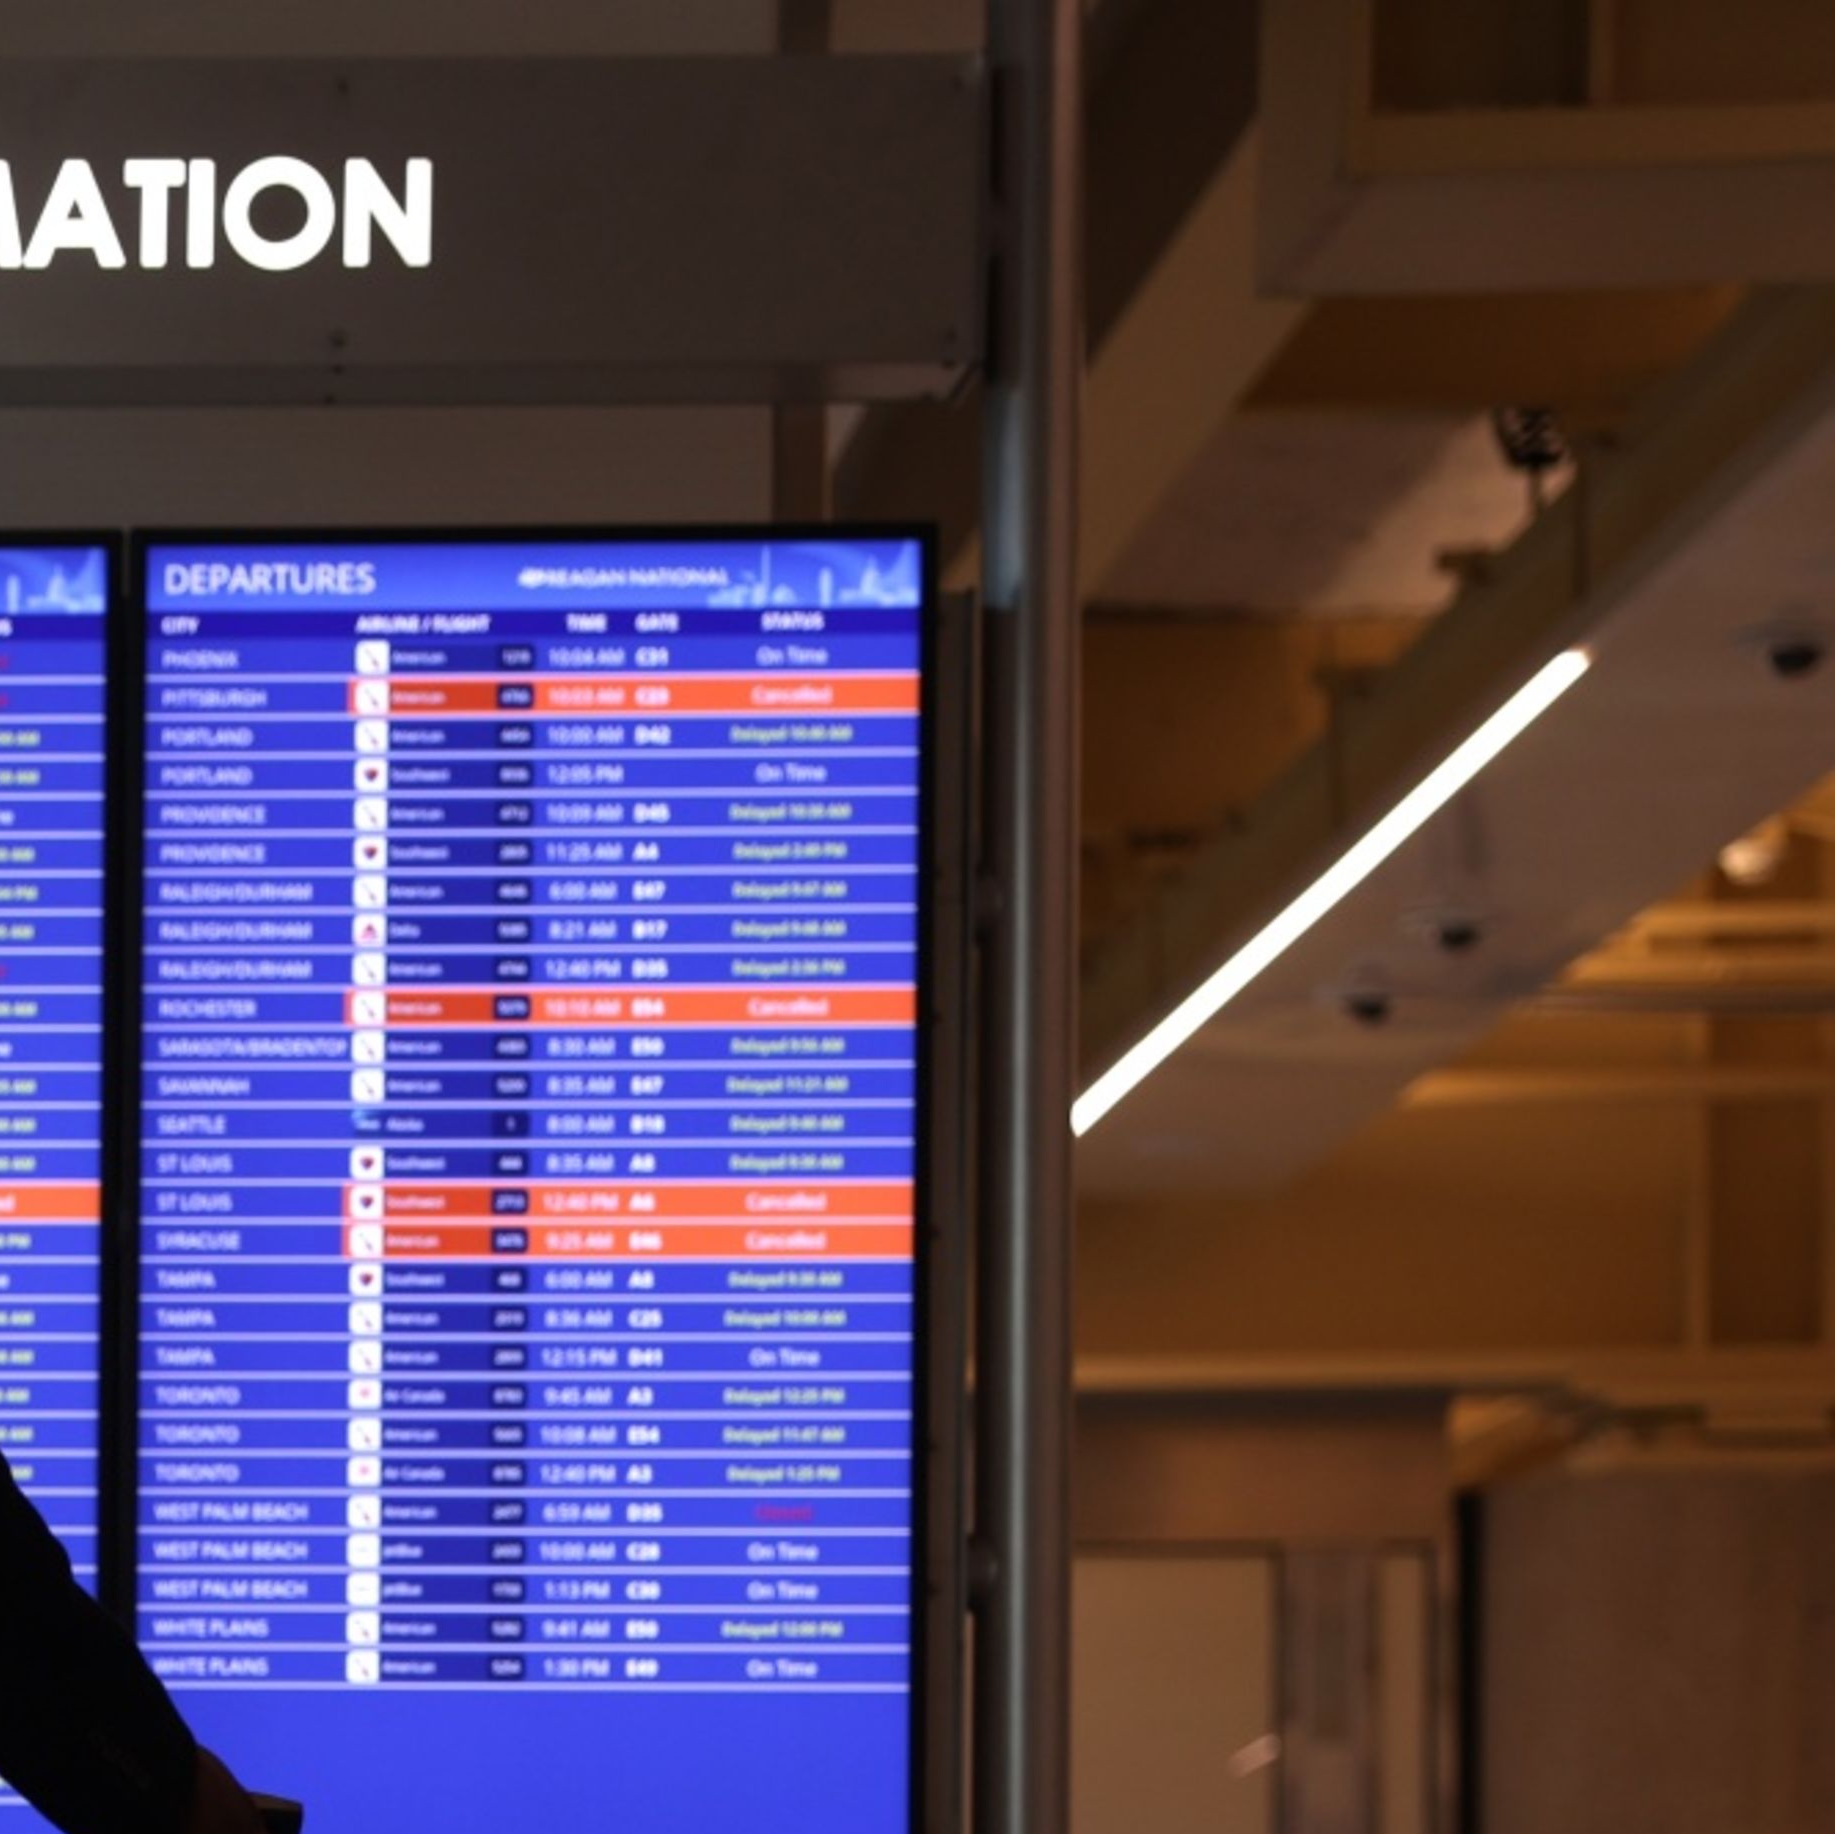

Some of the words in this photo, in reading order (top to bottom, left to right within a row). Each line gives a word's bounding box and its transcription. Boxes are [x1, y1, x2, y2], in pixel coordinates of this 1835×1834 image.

[163, 562, 378, 596] DEPARTURES
[543, 568, 626, 587] REAGAN
[629, 567, 729, 587] NATIONAL
[160, 616, 201, 634] CITY
[354, 613, 420, 634] AIRLINE
[432, 613, 491, 634] FLIGHT
[565, 613, 608, 632] TIME
[633, 613, 680, 632] GATE
[760, 611, 826, 630] STATUS
[160, 649, 240, 669] PHOENIX
[755, 646, 786, 666] On
[785, 645, 830, 665] Time
[160, 688, 268, 708] PITTSBURGH
[750, 686, 834, 705] Cancelled
[160, 727, 255, 747] PORTLAND
[160, 766, 254, 785] PORTLAND
[591, 764, 625, 783] PM
[754, 763, 785, 782] On
[784, 762, 828, 782] Time
[159, 805, 267, 824] PROVIDENCE
[159, 844, 267, 863] PROVIDENCE
[590, 843, 624, 861] AM
[158, 883, 315, 902] RALEIGH/DURHAM
[158, 921, 314, 941] RALEIGH/DURHAM
[158, 960, 314, 979] RALEIGH/DURHAM
[157, 998, 258, 1018] ROCHESTER
[747, 998, 830, 1016] Cancelled
[157, 1077, 252, 1095] SAVANNAH
[157, 1114, 227, 1135] SEATTLE
[156, 1153, 180, 1173] ST
[176, 1154, 234, 1173] LOUIS
[155, 1192, 180, 1212] ST
[176, 1193, 234, 1212] LOUIS
[745, 1193, 828, 1211] Cancelled
[156, 1231, 242, 1250] SYRACUSE
[744, 1232, 827, 1250] Cancelled
[156, 1270, 217, 1288] TAMPA
[155, 1308, 217, 1327] TAMPA
[155, 1347, 216, 1365] TAMPA
[585, 1348, 619, 1366] PM
[748, 1348, 779, 1367] On
[777, 1347, 822, 1366] Time
[154, 1386, 242, 1405] TORONTO
[580, 1387, 614, 1405] AM
[154, 1424, 242, 1443] TORONTO
[154, 1463, 241, 1482] TORONTO
[584, 1464, 618, 1482] PM
[153, 1502, 201, 1520] WEST
[200, 1502, 252, 1521] PALM
[248, 1502, 310, 1521] BEACH
[152, 1540, 201, 1559] WEST
[199, 1541, 252, 1560] PALM
[248, 1541, 310, 1560] BEACH
[746, 1542, 777, 1561] On
[776, 1541, 820, 1561] Time
[152, 1579, 200, 1598] WEST
[199, 1579, 251, 1598] PALM
[247, 1579, 309, 1599] BEACH
[746, 1581, 777, 1600] On
[776, 1580, 820, 1599] Time
[152, 1618, 209, 1637] WHITE
[207, 1618, 270, 1637] PLAINS
[579, 1620, 612, 1638] AM
[152, 1656, 208, 1676] WHITE
[206, 1657, 270, 1676] PLAINS
[745, 1659, 776, 1678] On
[775, 1658, 819, 1677] Time
